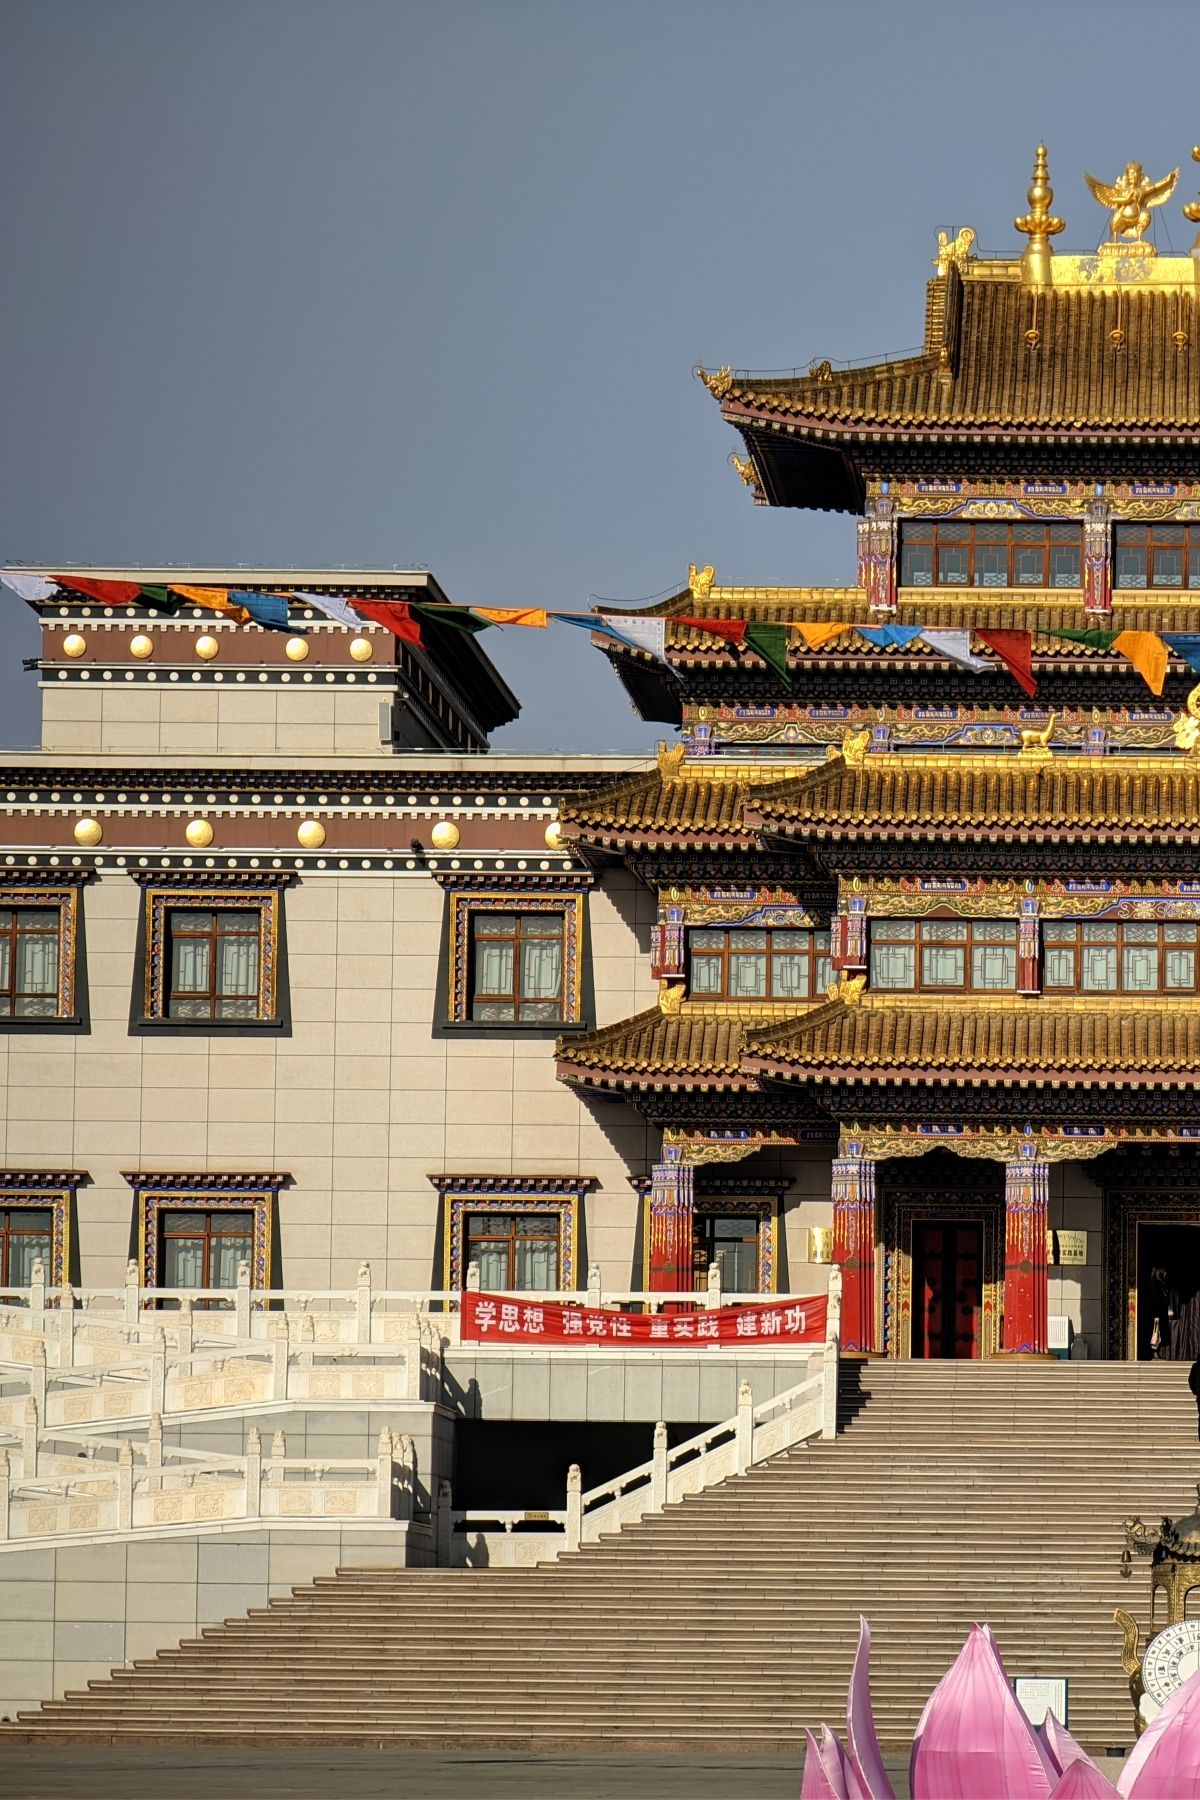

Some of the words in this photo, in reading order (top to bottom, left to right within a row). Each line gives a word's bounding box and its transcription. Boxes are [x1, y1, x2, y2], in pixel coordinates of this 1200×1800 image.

[474, 1301, 545, 1333] 学思想
[561, 1311, 632, 1337] 强党性
[736, 1305, 806, 1336] 建新功
